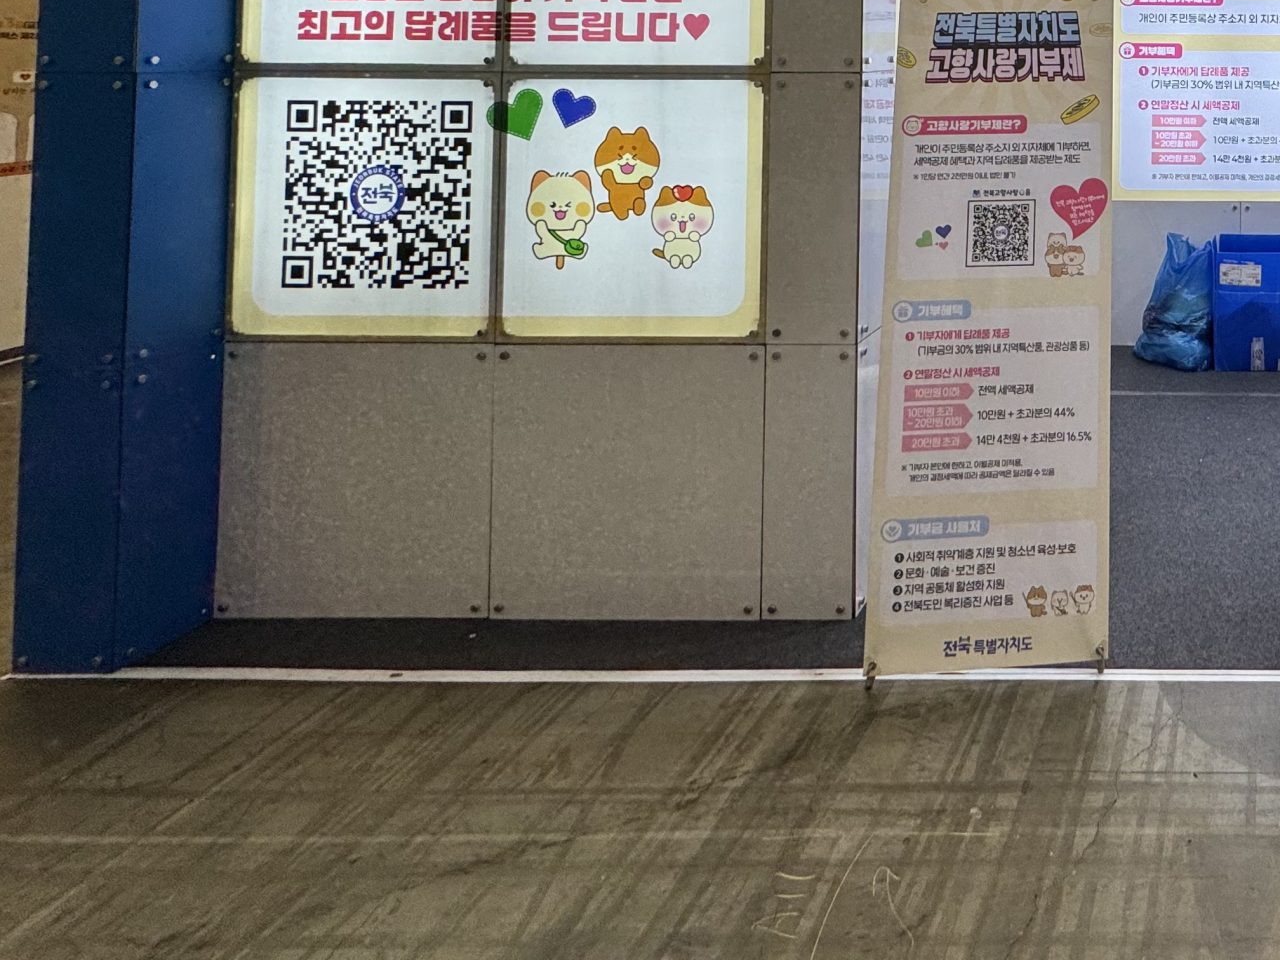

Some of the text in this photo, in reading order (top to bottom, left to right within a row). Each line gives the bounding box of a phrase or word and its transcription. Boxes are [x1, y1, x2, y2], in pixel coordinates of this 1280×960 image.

[1139, 13, 1167, 24] 개인이
[1219, 13, 1246, 24] 주소지
[297, 10, 680, 42] 최고의 답례품을 드립니다
[933, 11, 1081, 47] 전북특별자치도
[925, 46, 1085, 83] 고향사랑기부제
[1152, 67, 1198, 77] 기부자에게
[1231, 67, 1249, 77] 제공
[1190, 80, 1213, 89] 30%
[1151, 100, 1188, 110] 연말정산
[987, 143, 1010, 153] 주소지
[978, 154, 1081, 165] 지역 제도
[361, 183, 395, 204] 전북
[955, 345, 973, 355] 30%
[1054, 407, 1075, 417] 44%
[906, 550, 935, 563] 사회적
[976, 547, 994, 559] 지원
[1008, 545, 1035, 557] 청소년
[905, 568, 924, 579] 문화
[956, 564, 975, 576] 보건
[904, 584, 924, 595] 지역
[986, 579, 1005, 590] 지원
[984, 595, 1002, 607] 사업
